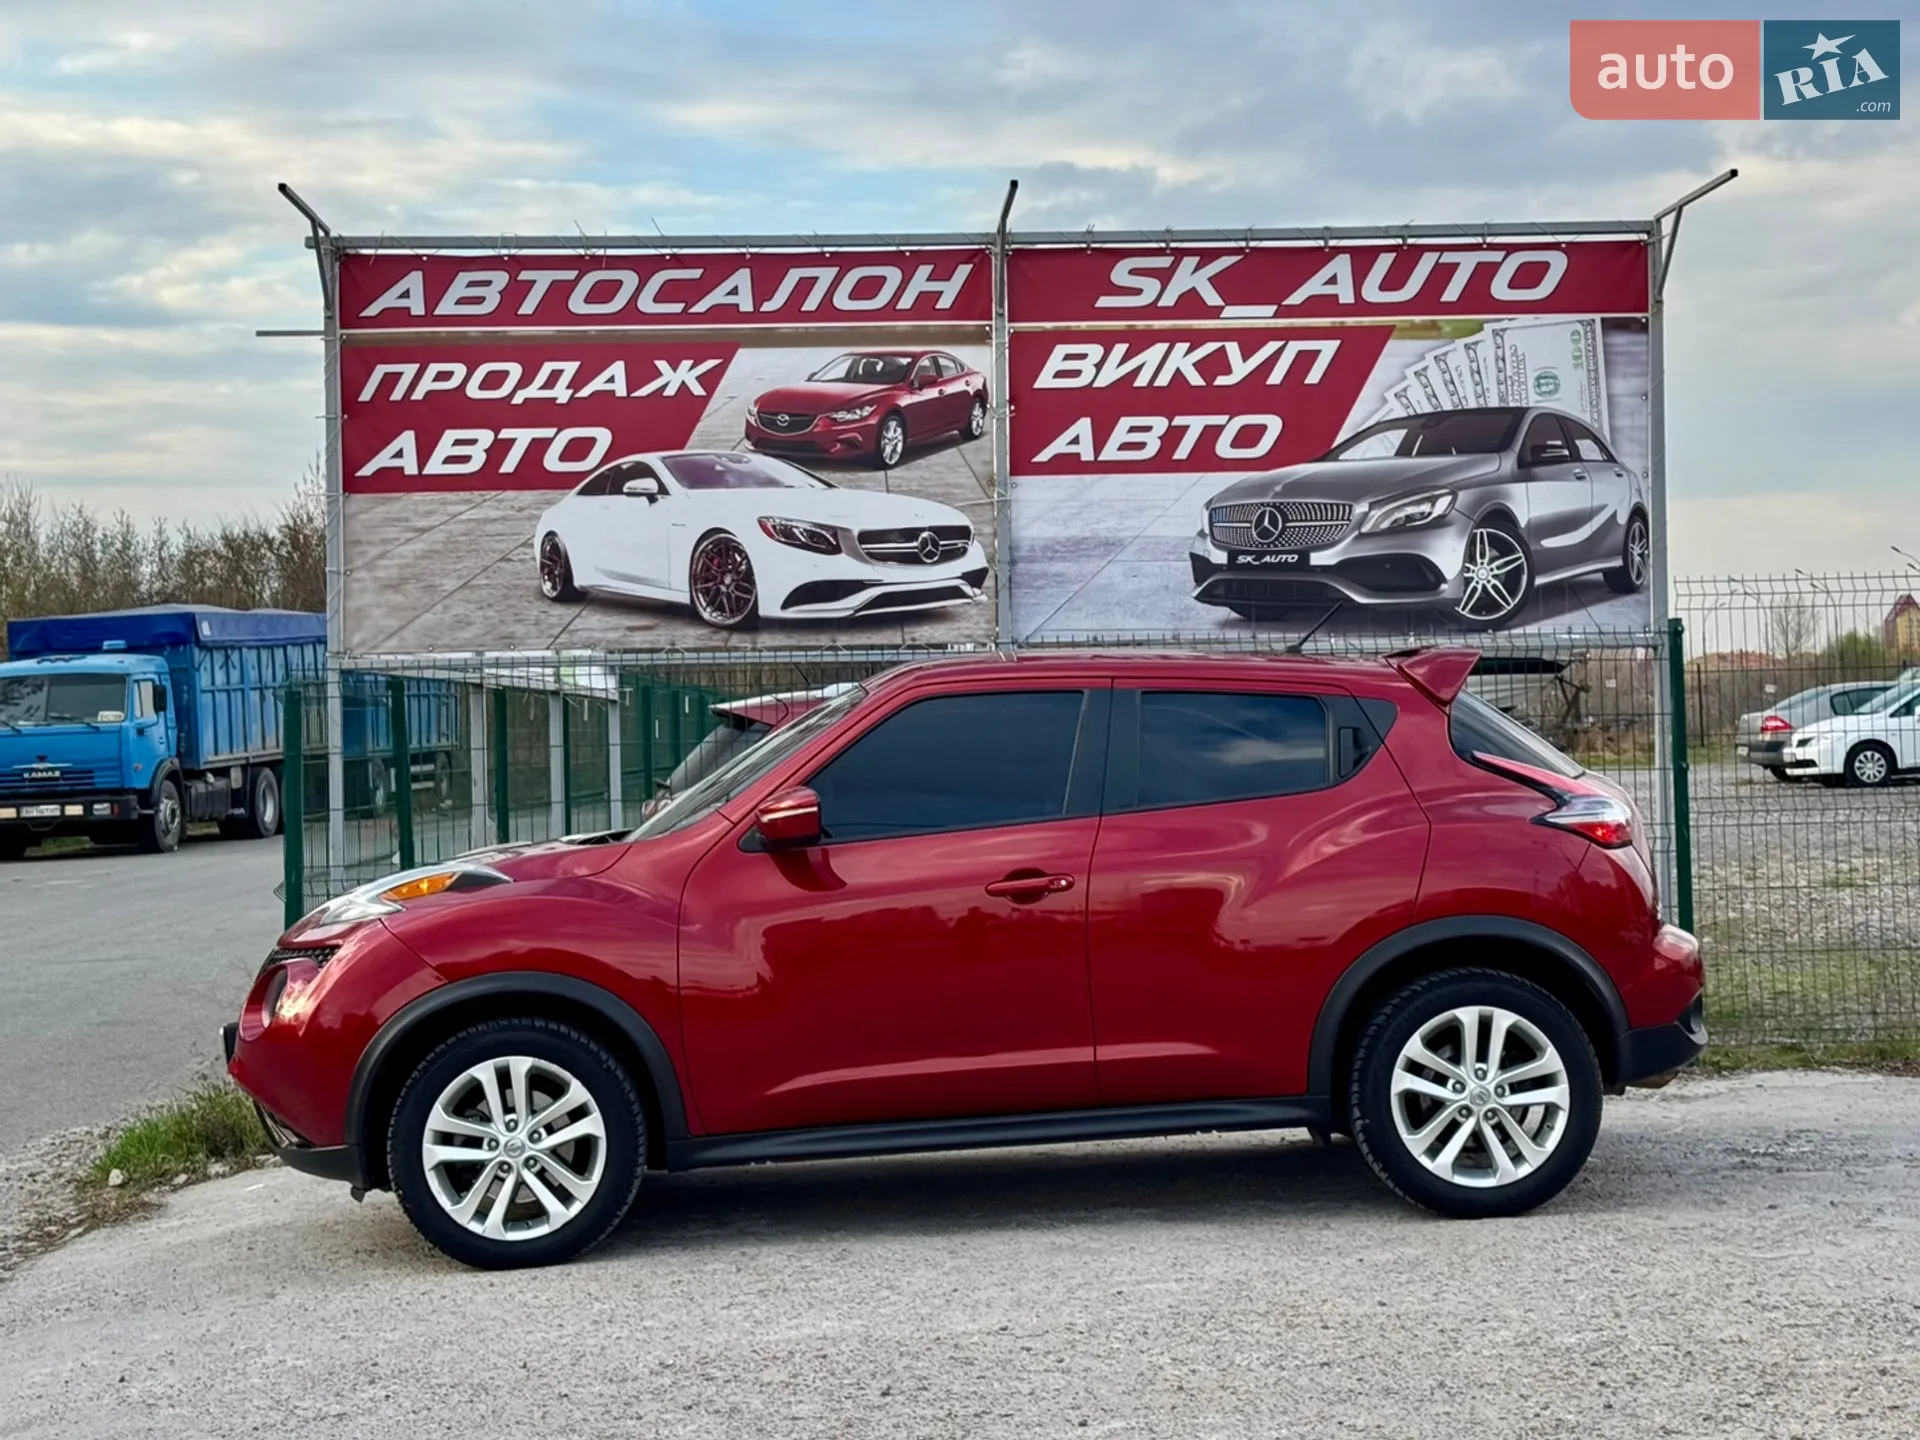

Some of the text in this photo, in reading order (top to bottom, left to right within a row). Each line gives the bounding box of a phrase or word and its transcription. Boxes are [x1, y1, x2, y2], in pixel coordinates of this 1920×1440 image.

[359, 264, 974, 318] АВТОСАЛОН
[1094, 250, 1568, 318] SK_AUTO
[357, 358, 724, 405] ПРОДАЖ
[1033, 339, 1342, 389] ВИКУП
[354, 426, 613, 477] АВТО
[1030, 414, 1284, 462] АВТО
[1236, 554, 1299, 565] SK_AUTO
